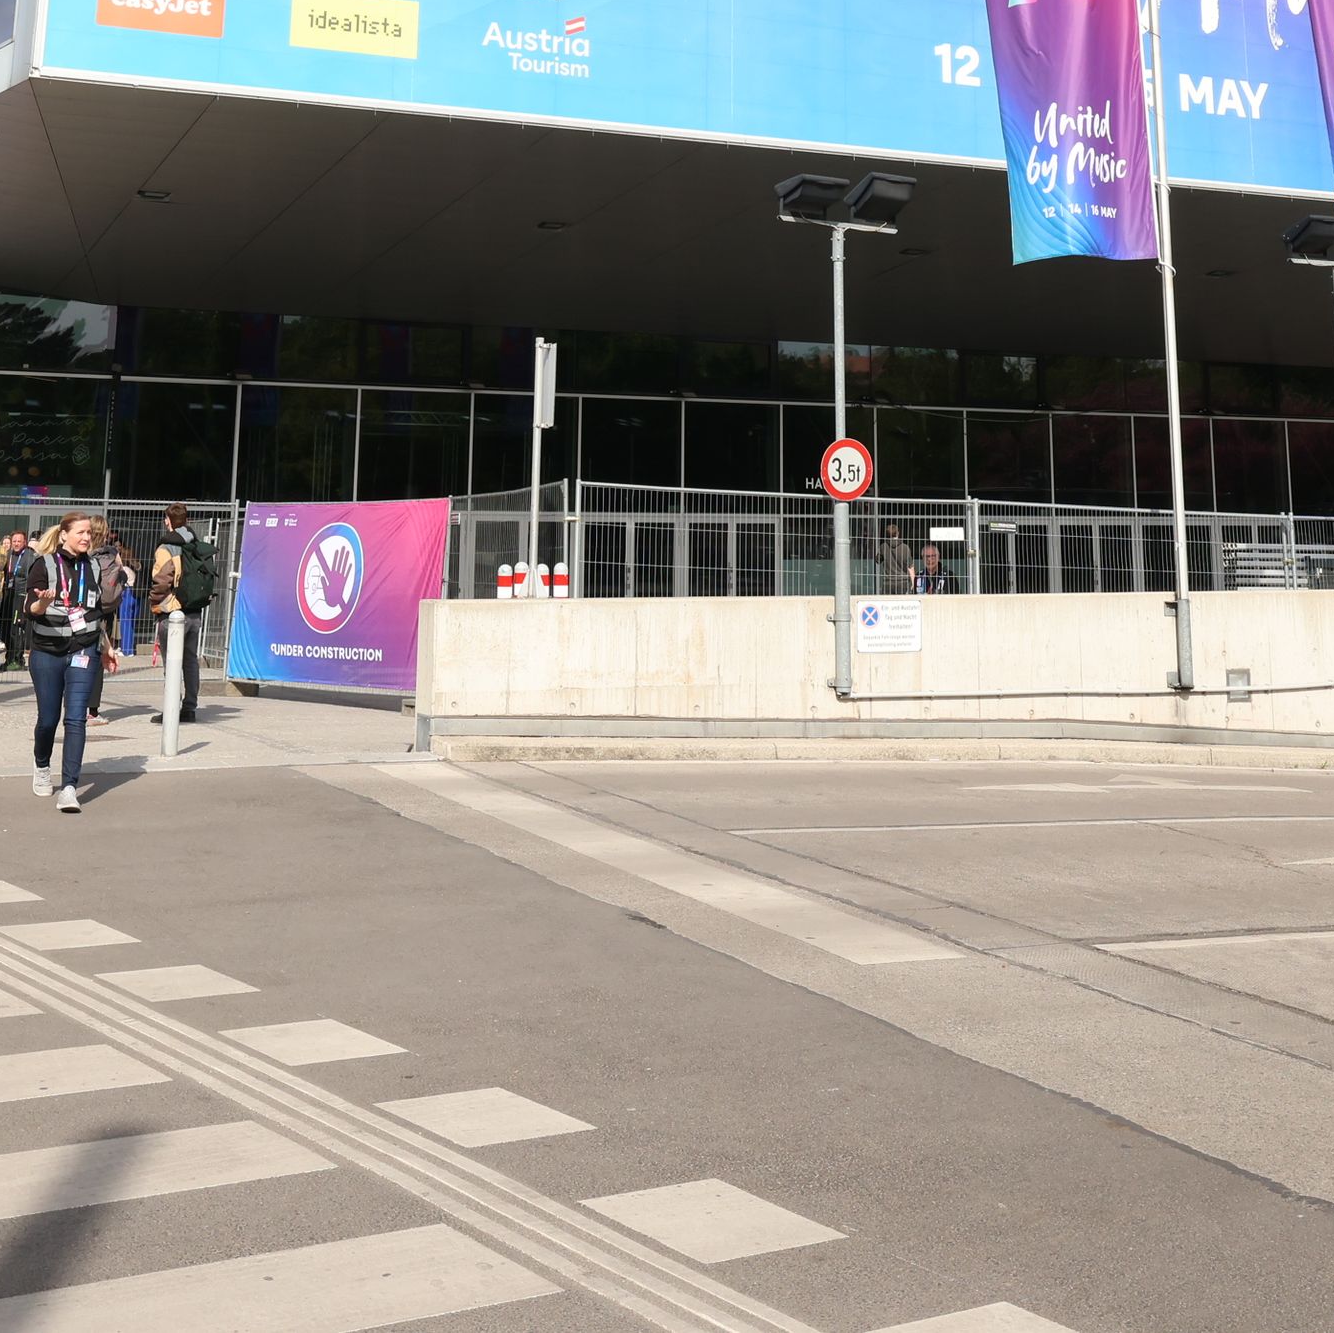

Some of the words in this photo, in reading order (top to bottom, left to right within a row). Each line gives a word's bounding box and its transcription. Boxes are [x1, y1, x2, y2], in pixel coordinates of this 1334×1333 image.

[308, 8, 403, 38] idealista
[482, 20, 590, 57] Austria
[508, 51, 589, 79] Tourism
[933, 44, 981, 87] 12
[1179, 73, 1268, 119] MAY
[1034, 100, 1113, 148] United
[1026, 145, 1058, 194] by
[1067, 141, 1127, 188] Music
[1043, 206, 1054, 218] 12
[1068, 205, 1082, 215] 14
[1090, 205, 1099, 216] 16
[1100, 206, 1117, 219] MAY
[832, 457, 860, 484] 3,5t
[271, 643, 304, 657] UNDER
[305, 645, 383, 661] CONSTRUCTION
